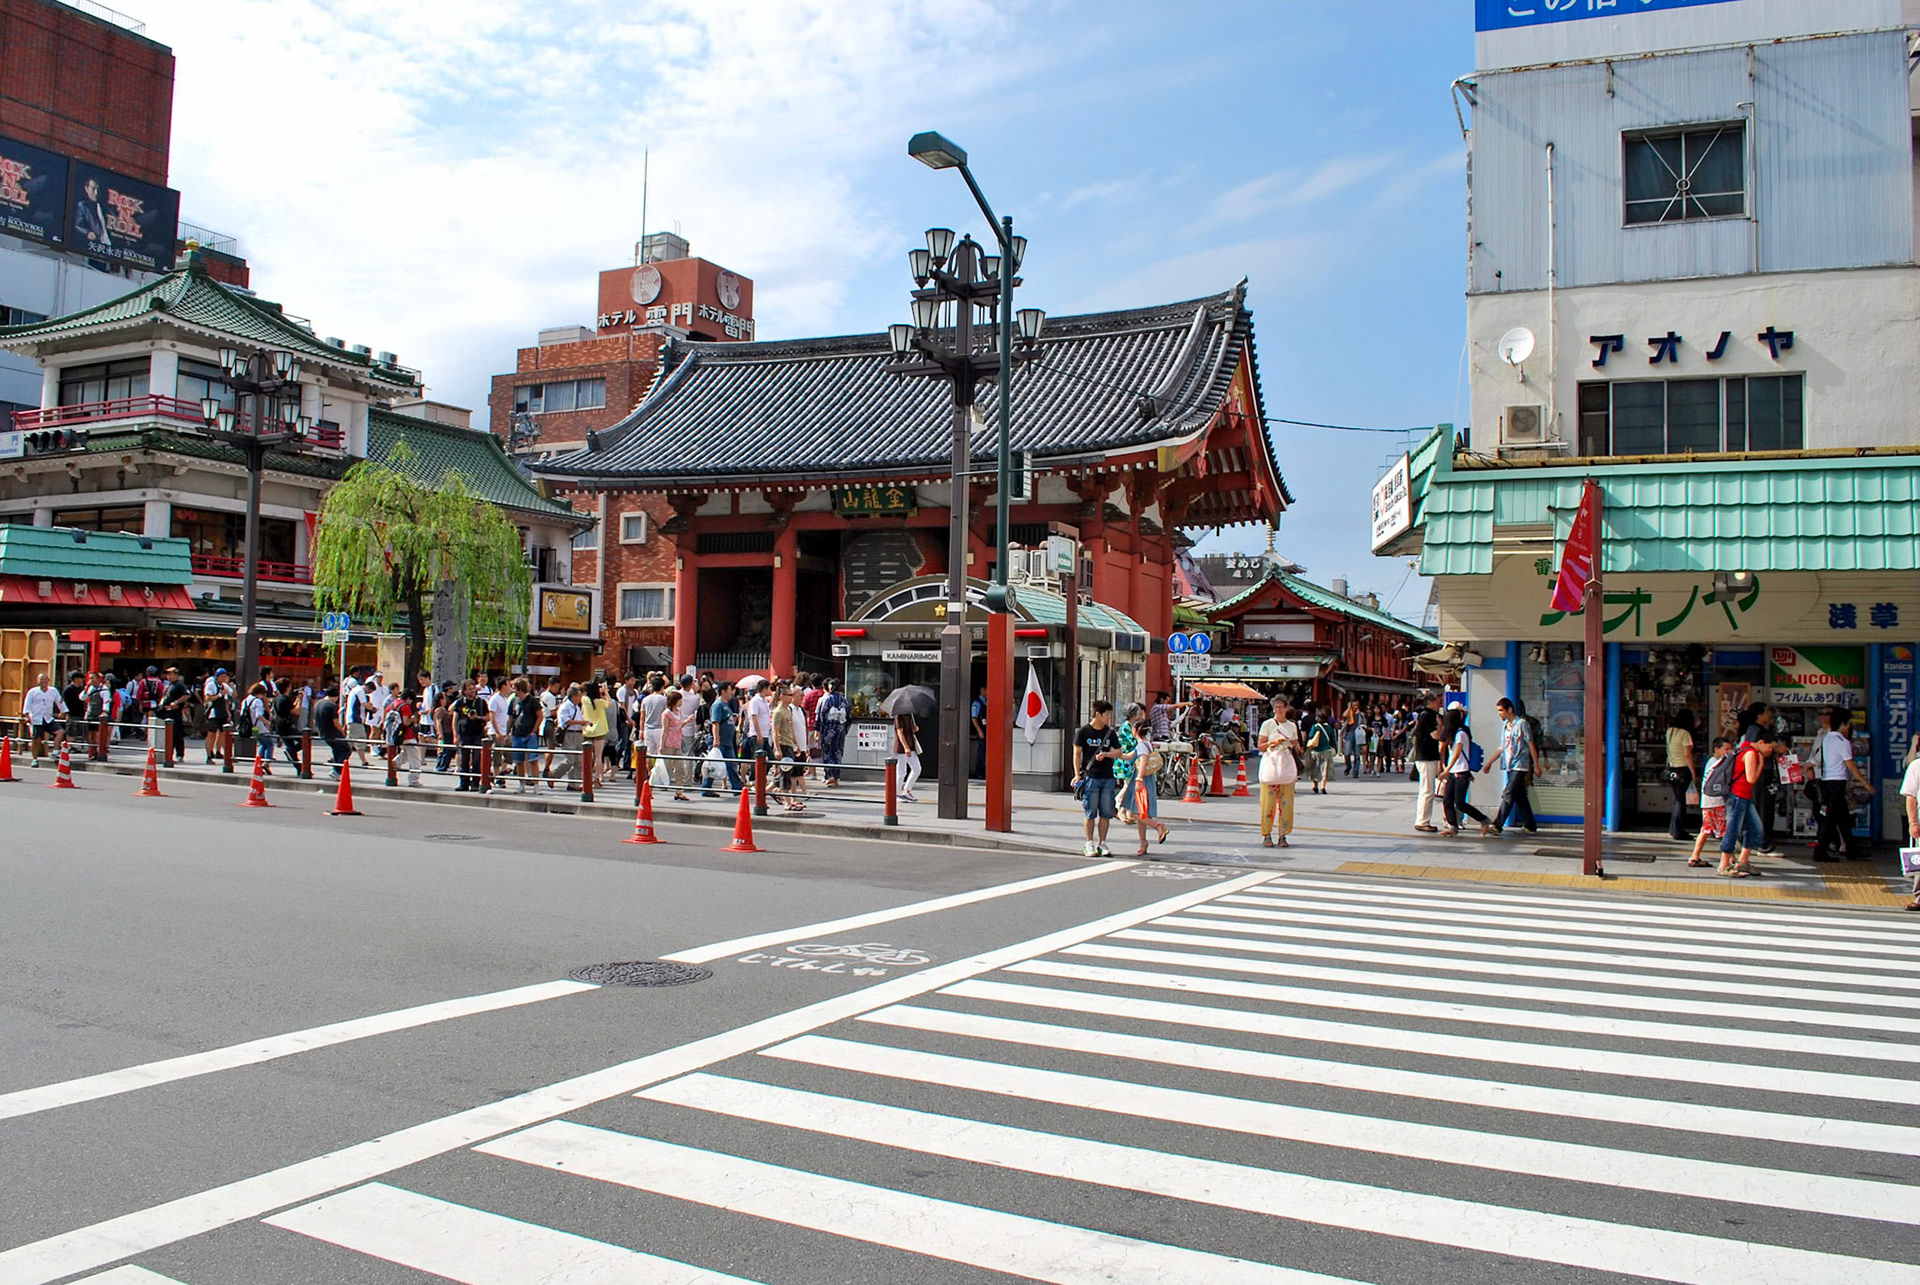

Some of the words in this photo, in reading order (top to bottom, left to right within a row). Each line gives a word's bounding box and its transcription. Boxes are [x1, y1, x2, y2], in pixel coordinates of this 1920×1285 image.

[107, 188, 144, 214] ROCK
[106, 213, 143, 239] ROLL
[1590, 326, 1794, 367] アオノヤ
[1828, 603, 1900, 629] 浅草
[886, 652, 939, 661] KAMINARIMON
[1883, 662, 1914, 671] Konica
[1774, 673, 1860, 685] FUJICOLOR
[1889, 678, 1907, 773] コニカカラー
[738, 953, 888, 976] じてんしゃ
